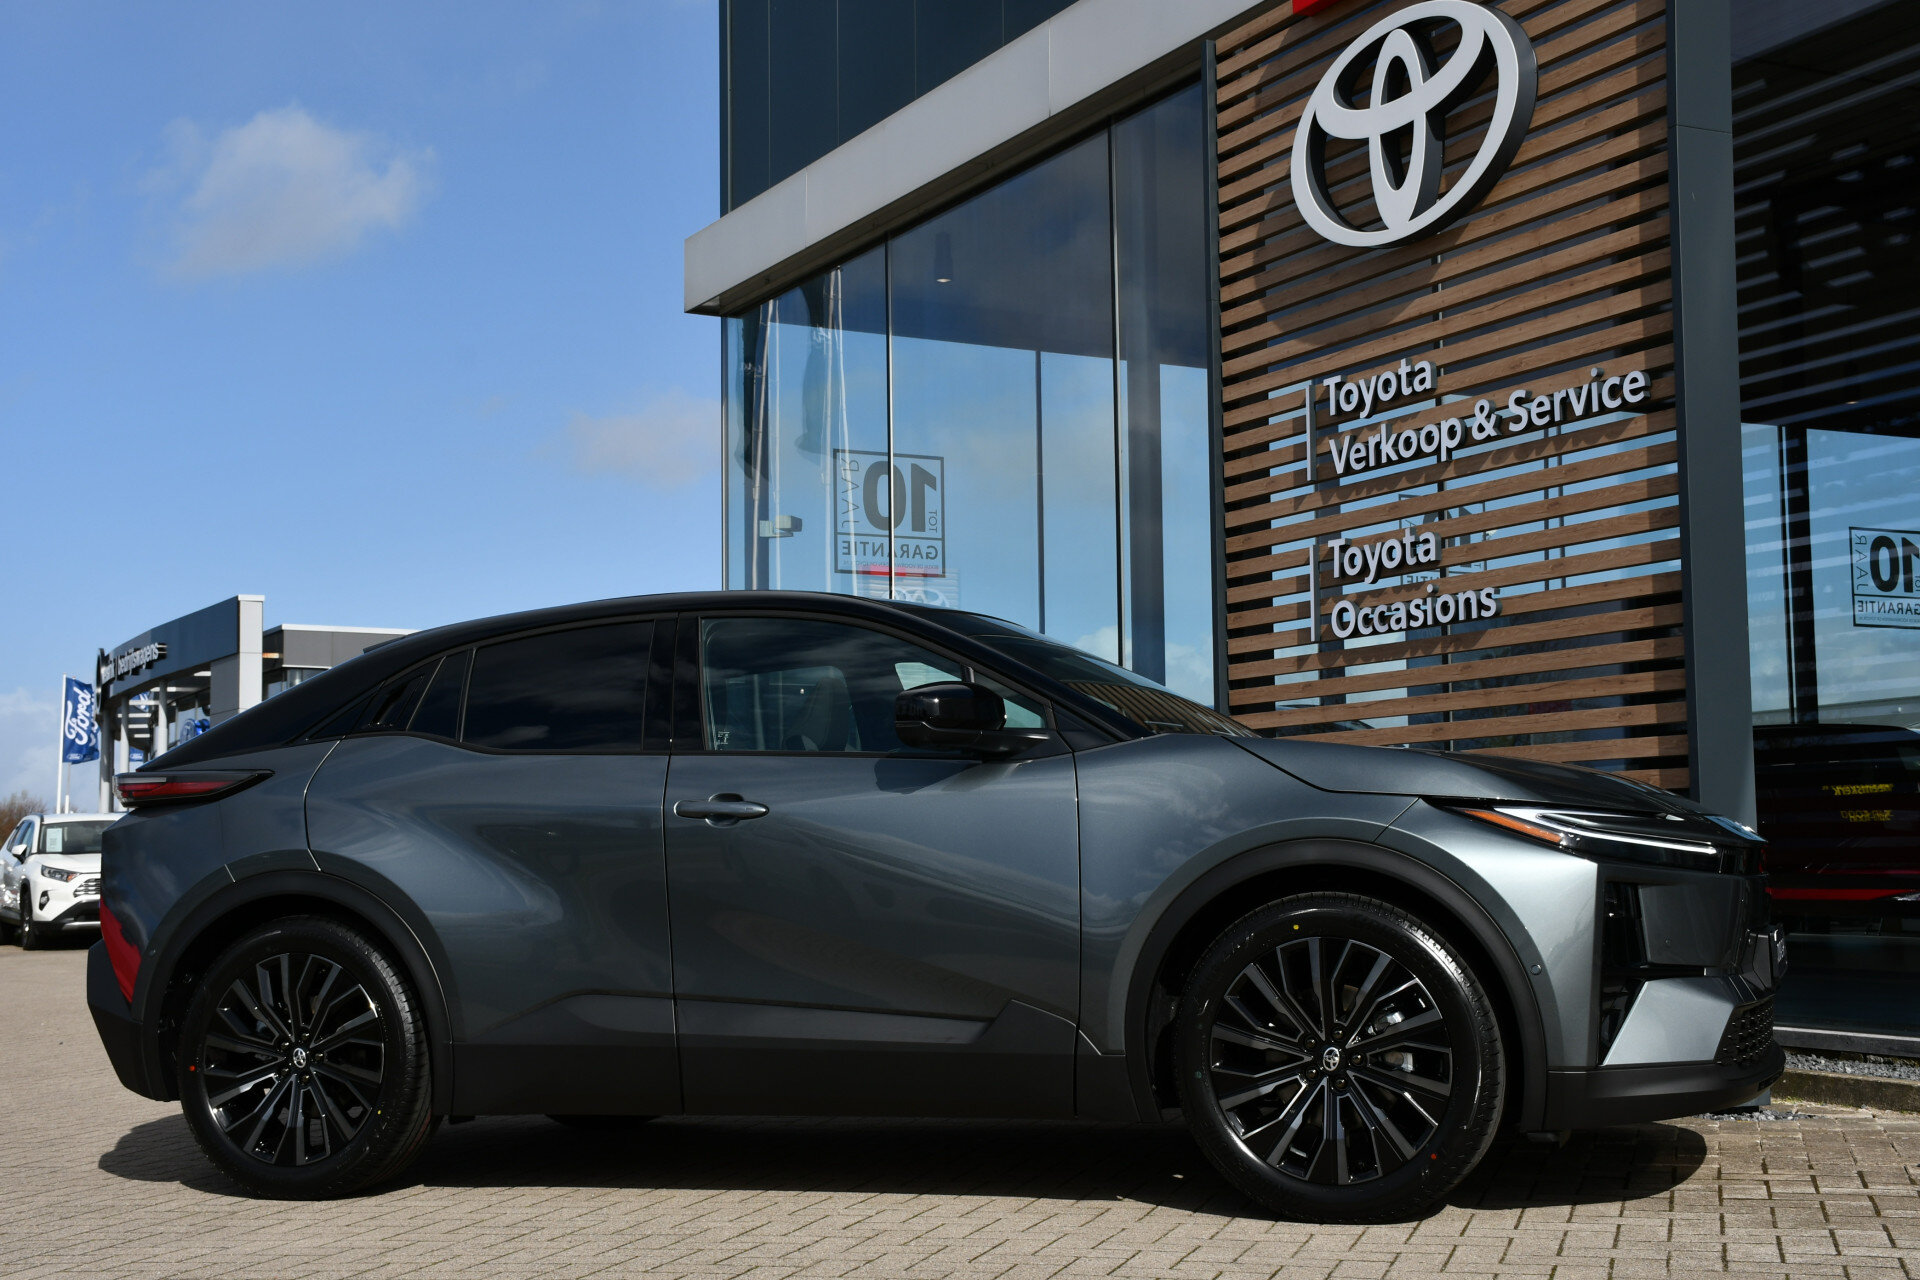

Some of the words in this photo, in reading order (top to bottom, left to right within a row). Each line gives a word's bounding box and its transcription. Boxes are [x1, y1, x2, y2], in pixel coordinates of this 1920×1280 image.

[1323, 358, 1434, 419] Toyota
[1329, 417, 1464, 475] Verkoop
[1472, 399, 1500, 441] &
[1508, 367, 1649, 432] Service
[1328, 527, 1439, 584] Toyota
[1331, 584, 1498, 639] Occasions
[65, 686, 92, 746] Ford
